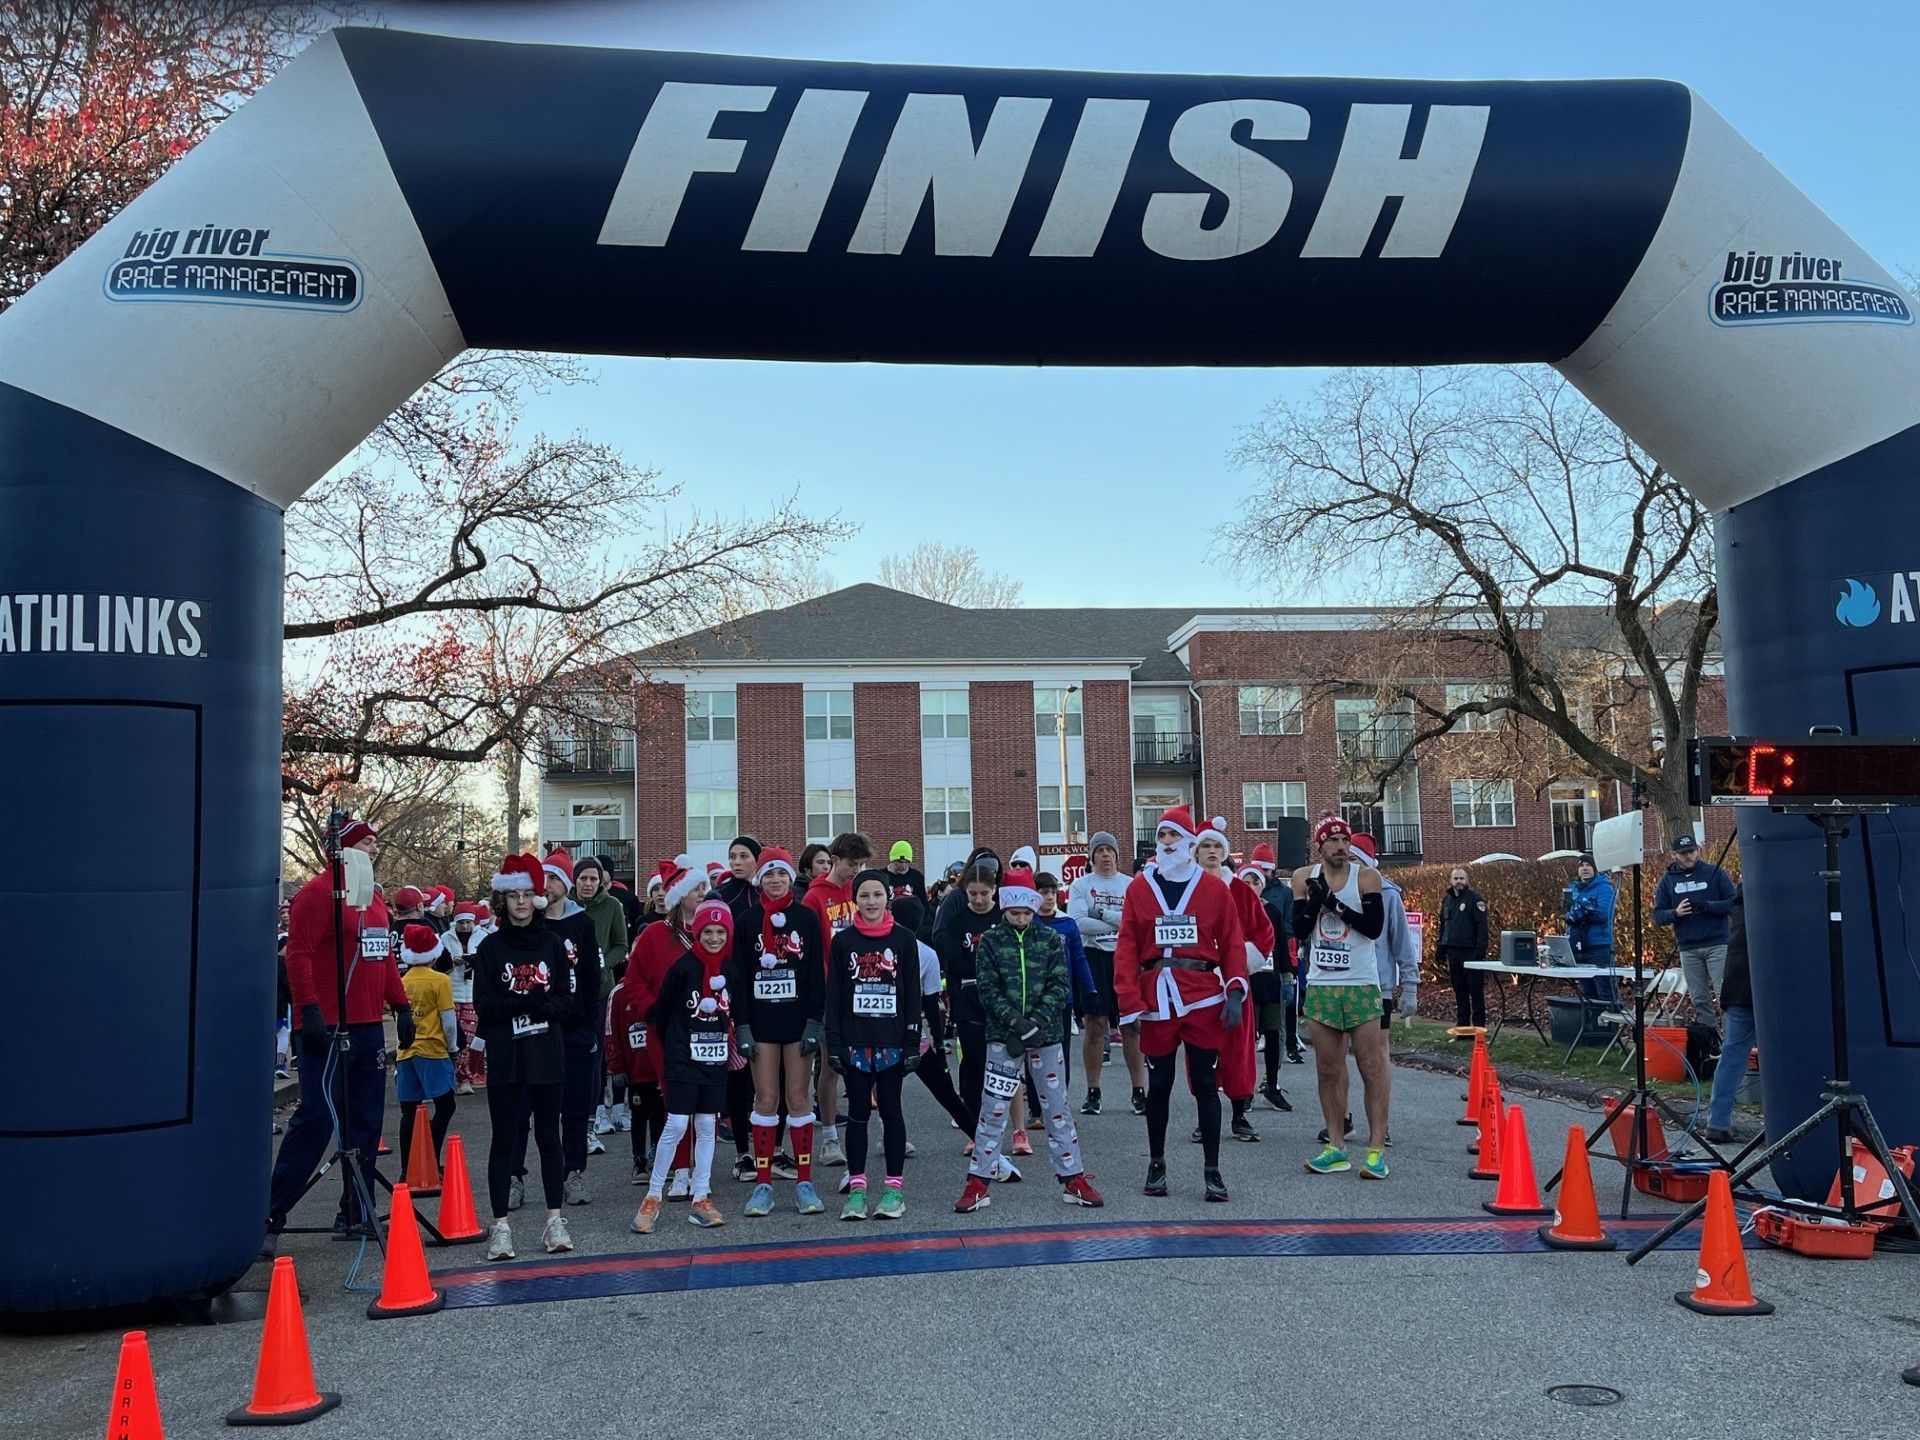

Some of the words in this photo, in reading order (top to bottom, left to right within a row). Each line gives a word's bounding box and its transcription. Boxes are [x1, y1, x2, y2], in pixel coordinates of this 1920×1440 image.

[596, 81, 1490, 260] FINISH
[123, 227, 180, 259] big
[181, 224, 270, 256] river
[1722, 251, 1774, 284] big
[1779, 251, 1842, 281] river
[116, 265, 179, 289] RACE
[184, 265, 348, 299] MANAGEMENT
[1722, 290, 1779, 315] RACE
[1784, 289, 1904, 315] MANAGEMENT
[0, 594, 202, 657] ATHLINKS
[1063, 866, 1086, 880] STO
[1158, 928, 1195, 940] 11932
[1315, 951, 1349, 964] 12398
[758, 983, 791, 995] 12211
[857, 997, 893, 1009] 12215
[631, 1034, 645, 1044] 12
[694, 1045, 725, 1057] 12213
[986, 1074, 1018, 1093] 12357
